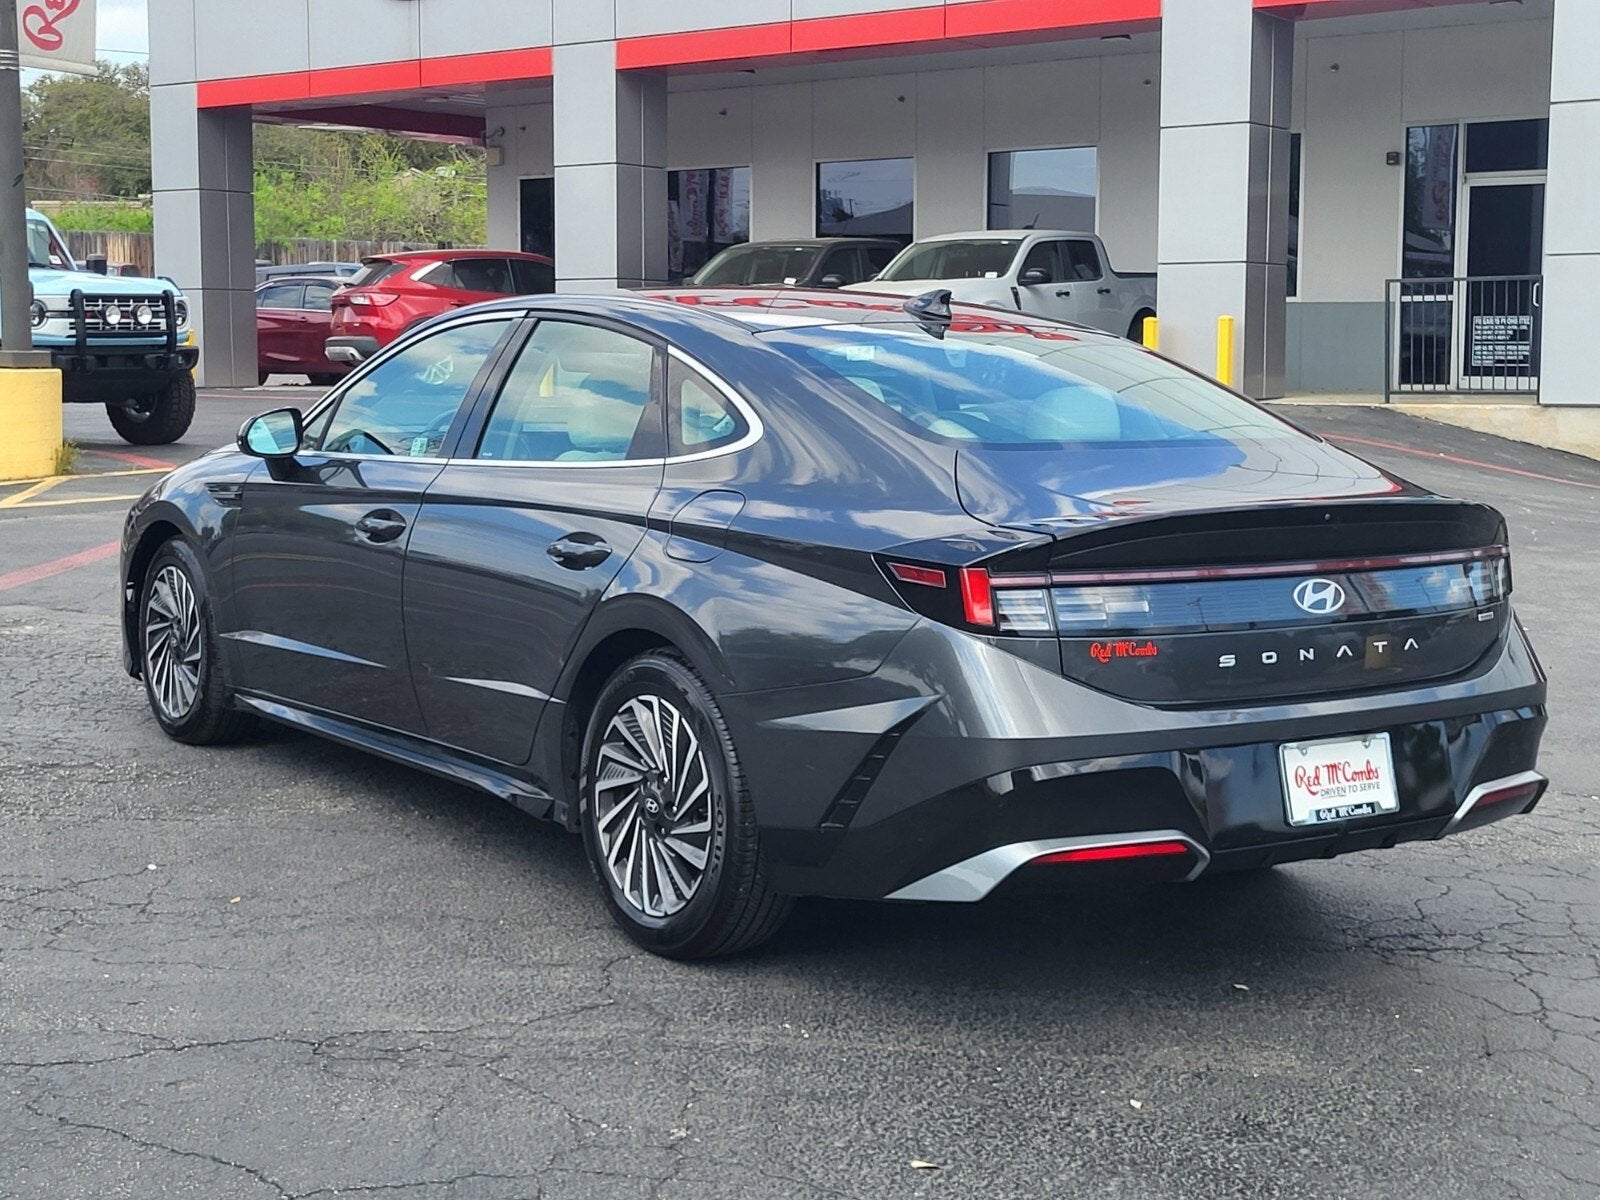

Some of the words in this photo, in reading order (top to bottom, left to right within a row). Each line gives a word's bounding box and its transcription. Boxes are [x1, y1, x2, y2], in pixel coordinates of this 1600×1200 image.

[1090, 641, 1112, 664] Red
[1218, 637, 1420, 668] SONATA
[1294, 764, 1321, 796] Red
[1321, 759, 1379, 785] McCombs
[1320, 785, 1347, 797] DRIVEN
[1348, 784, 1358, 793] TO
[1359, 781, 1381, 792] SERVE
